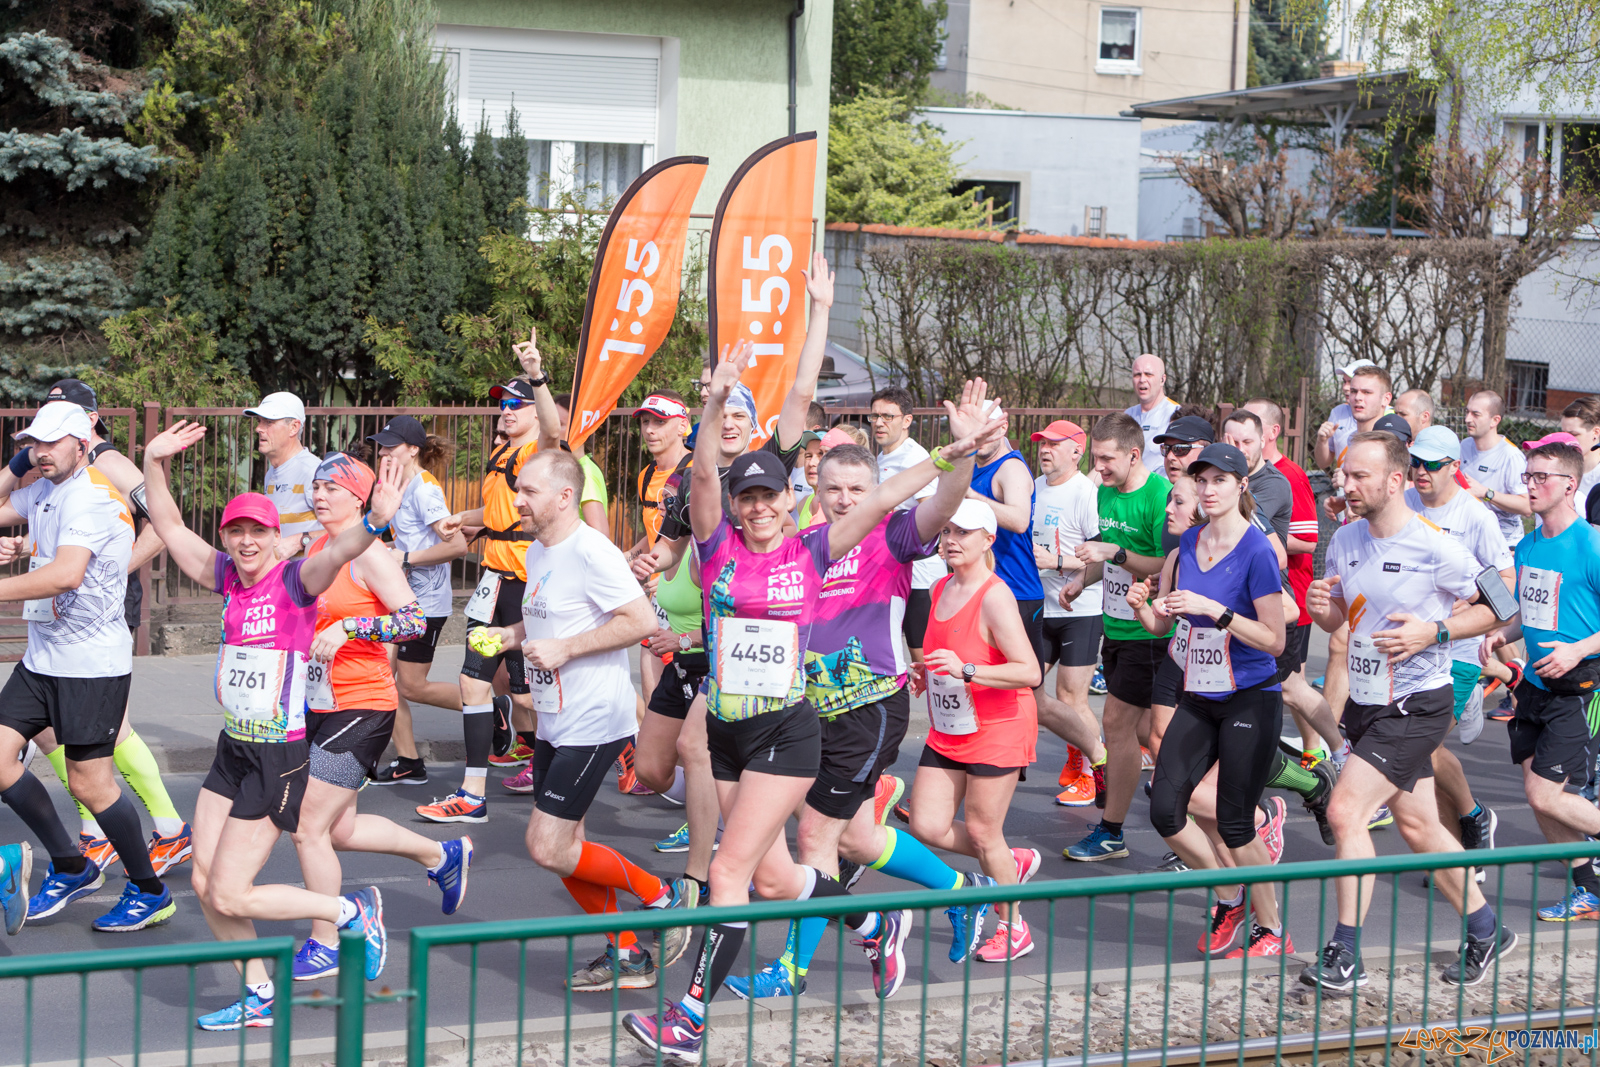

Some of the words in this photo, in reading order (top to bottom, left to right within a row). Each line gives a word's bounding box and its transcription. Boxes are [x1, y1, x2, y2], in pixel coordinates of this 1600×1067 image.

[599, 238, 660, 362] 1:55
[742, 234, 793, 368] 1:55
[768, 571, 804, 586] FSD
[767, 585, 804, 601] RUN
[1523, 586, 1549, 605] 4282
[245, 604, 275, 621] FSD
[241, 618, 276, 636] RUN
[731, 643, 785, 664] 4458
[1191, 649, 1222, 665] 11320
[1351, 655, 1380, 676] 2387
[228, 668, 266, 689] 2761
[932, 692, 960, 709] 1763
